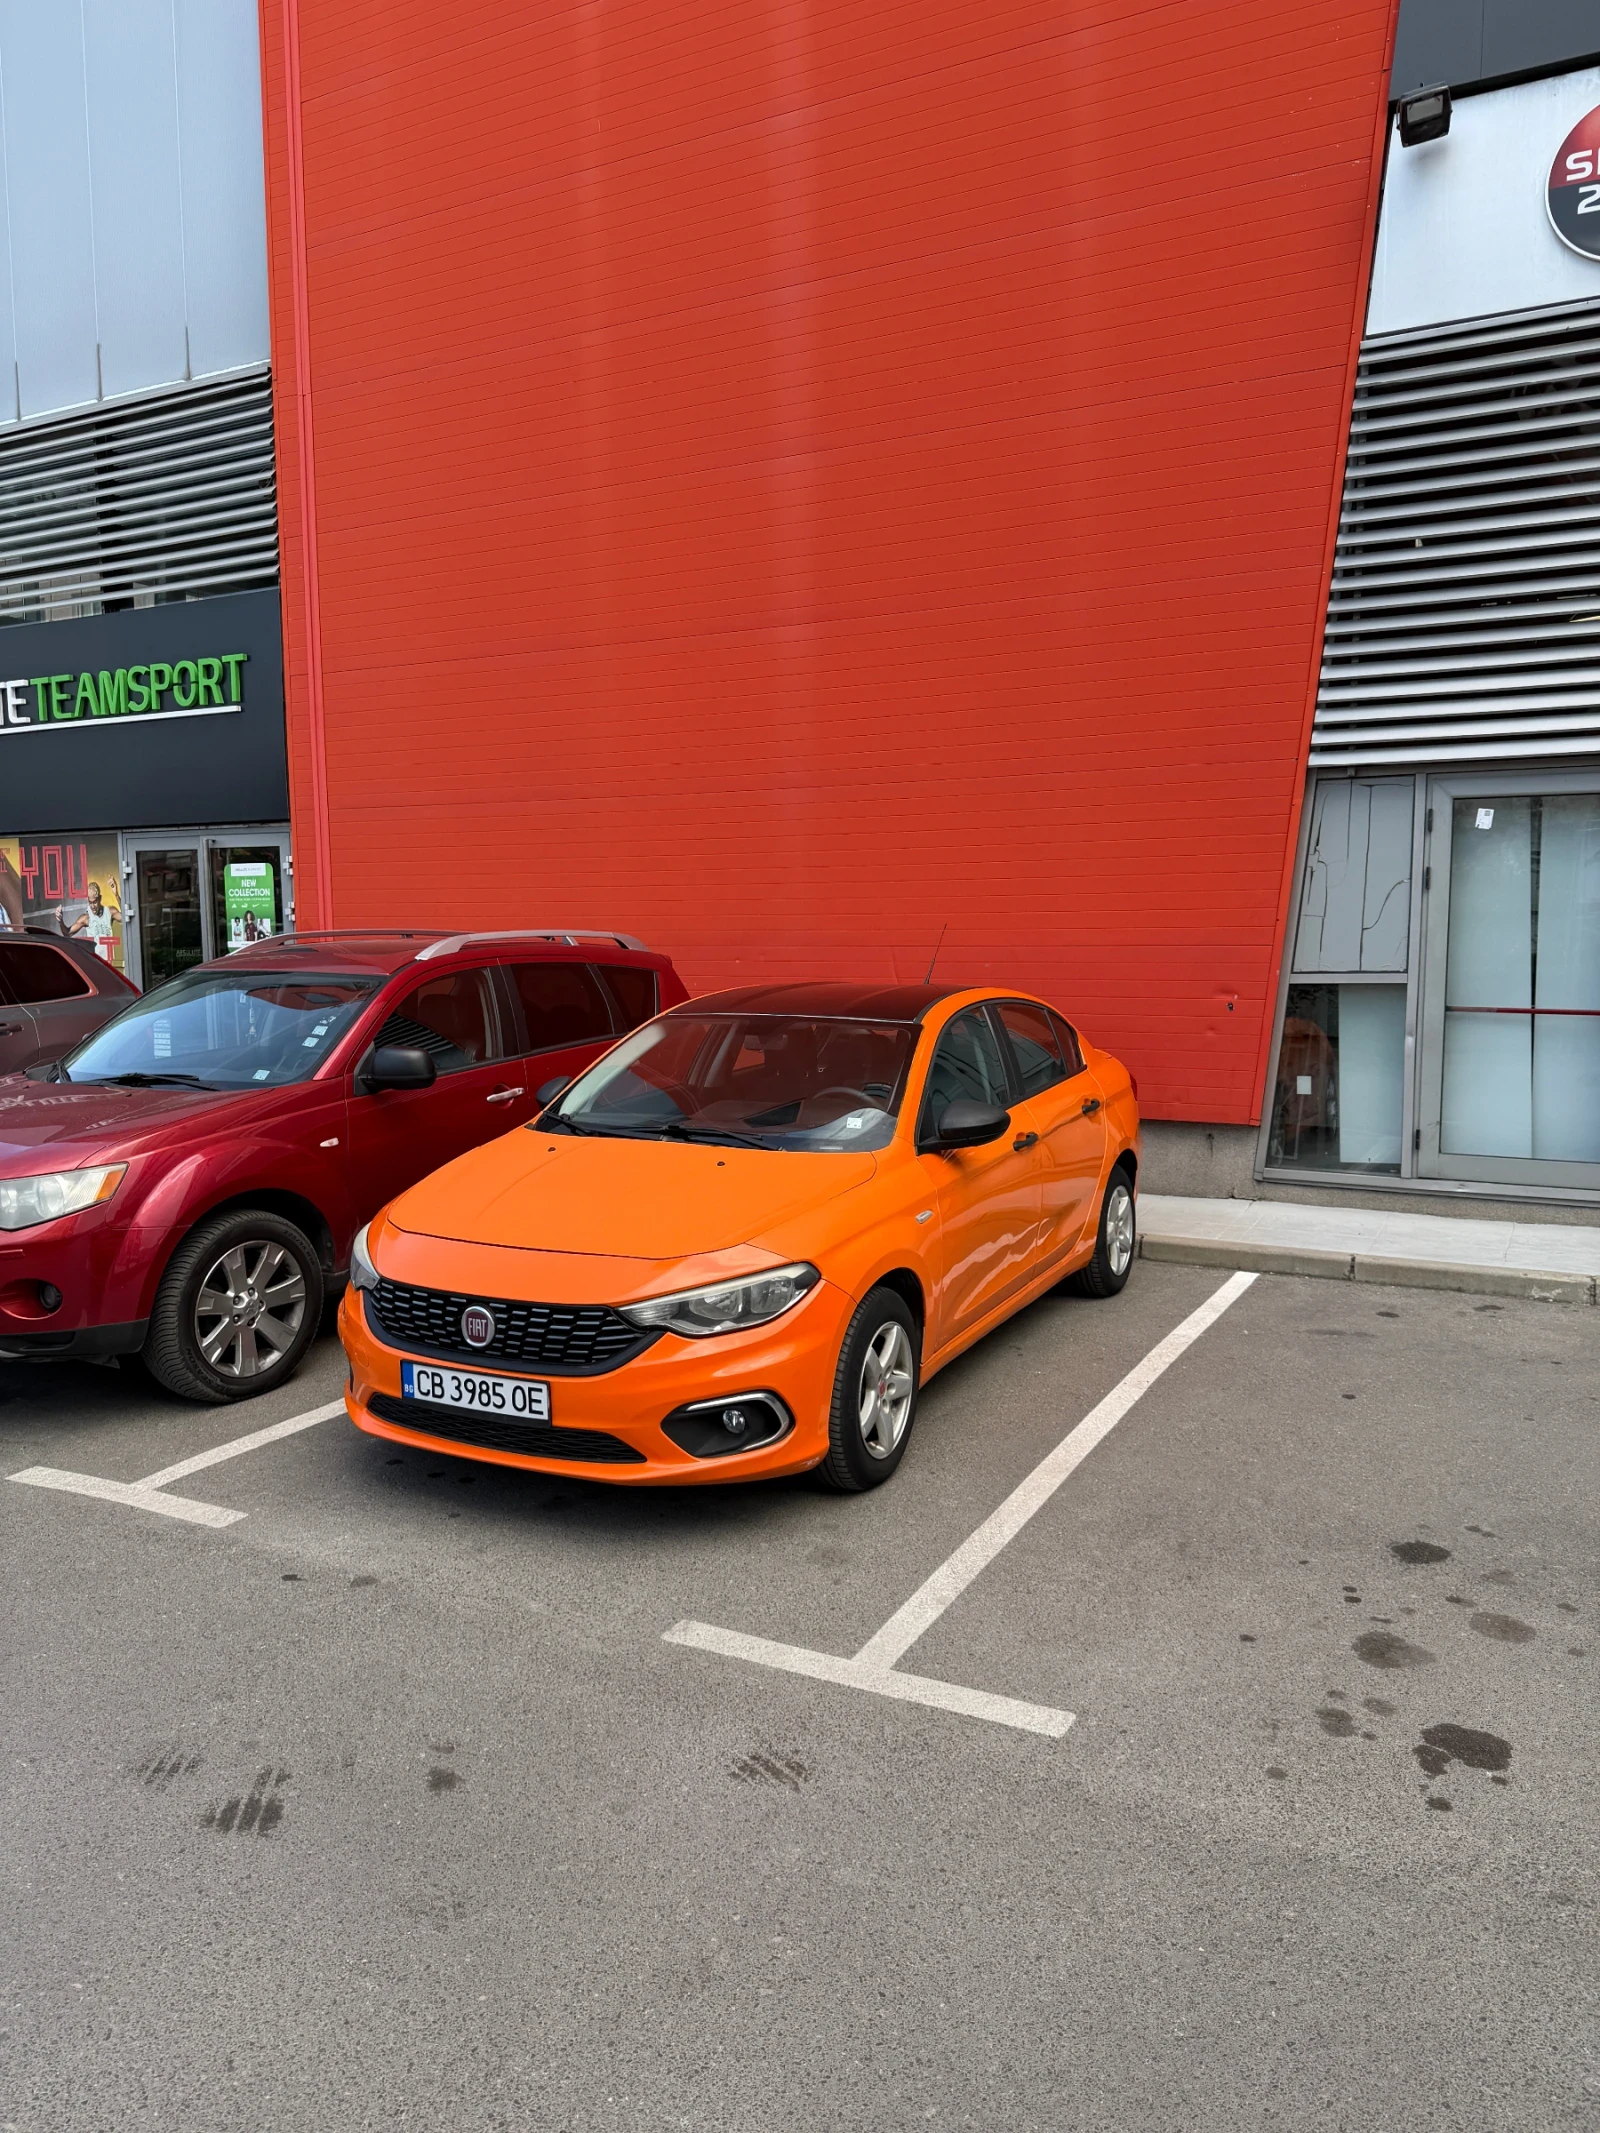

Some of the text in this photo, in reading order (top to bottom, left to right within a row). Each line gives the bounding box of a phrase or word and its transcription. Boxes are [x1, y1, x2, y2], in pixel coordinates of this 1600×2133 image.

[1566, 148, 1600, 181] S
[30, 653, 248, 722] TEAMSPORT
[20, 844, 88, 899] YOU
[241, 879, 256, 887] NEW
[228, 888, 270, 896] COLLECTION
[468, 1317, 487, 1338] FIAT
[404, 1384, 414, 1393] BG
[416, 1370, 445, 1399] CB
[450, 1375, 506, 1409] 3985
